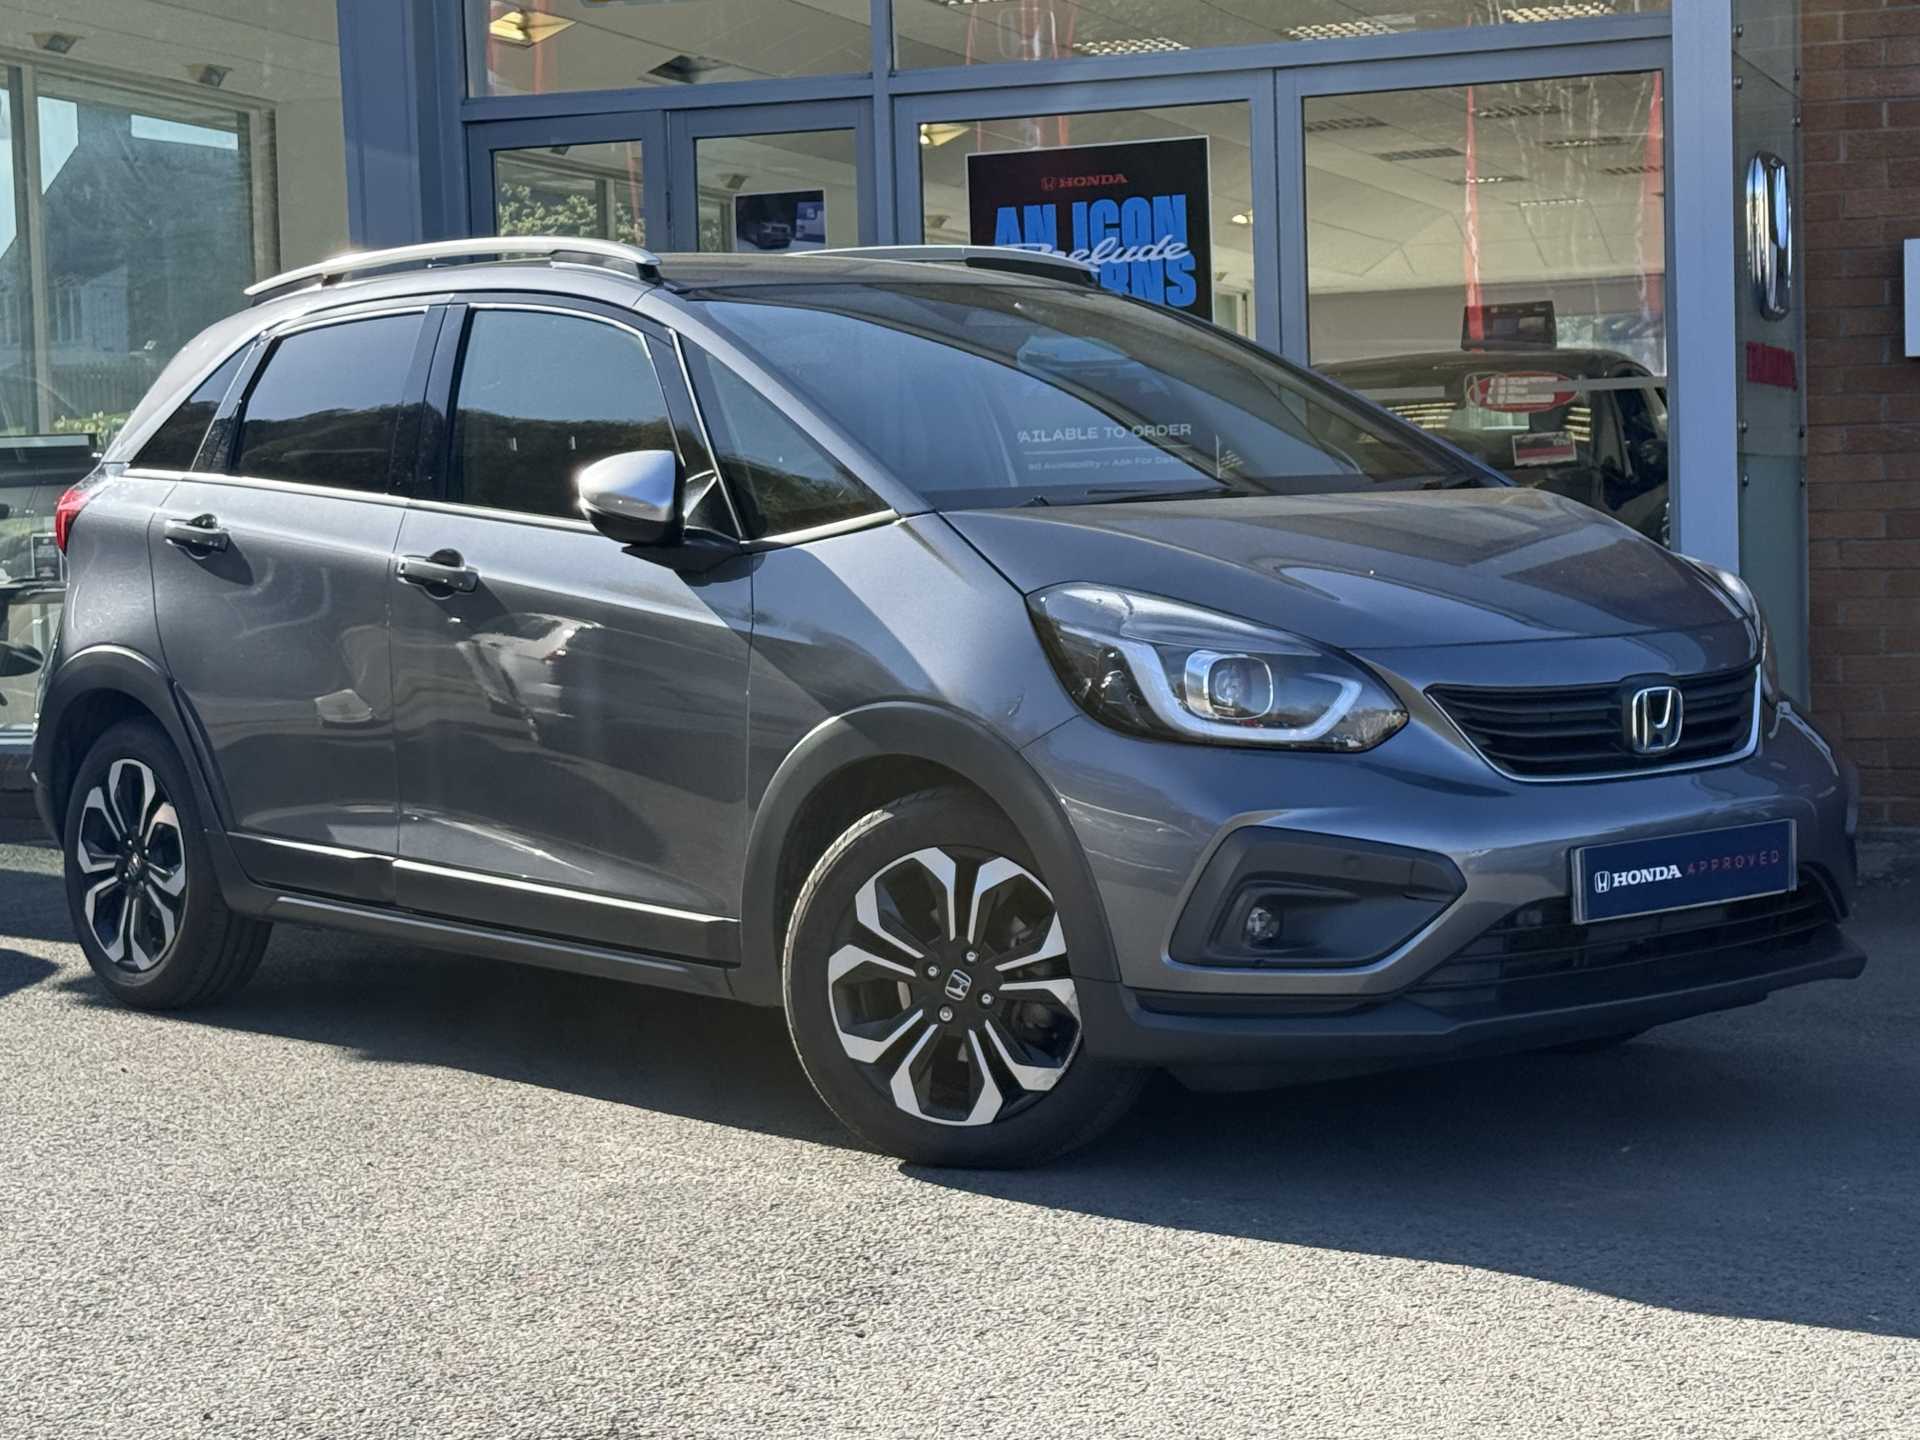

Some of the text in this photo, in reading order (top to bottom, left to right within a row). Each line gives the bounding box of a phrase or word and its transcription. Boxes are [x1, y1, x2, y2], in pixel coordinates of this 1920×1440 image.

[1057, 174, 1129, 189] HONDA
[994, 193, 1189, 252] AN ICON
[1001, 234, 1191, 265] relude
[1091, 252, 1197, 308] RNS
[1103, 425, 1127, 439] TO
[1132, 423, 1192, 438] ORDER
[1612, 849, 1780, 888] HONDA APPROVED
